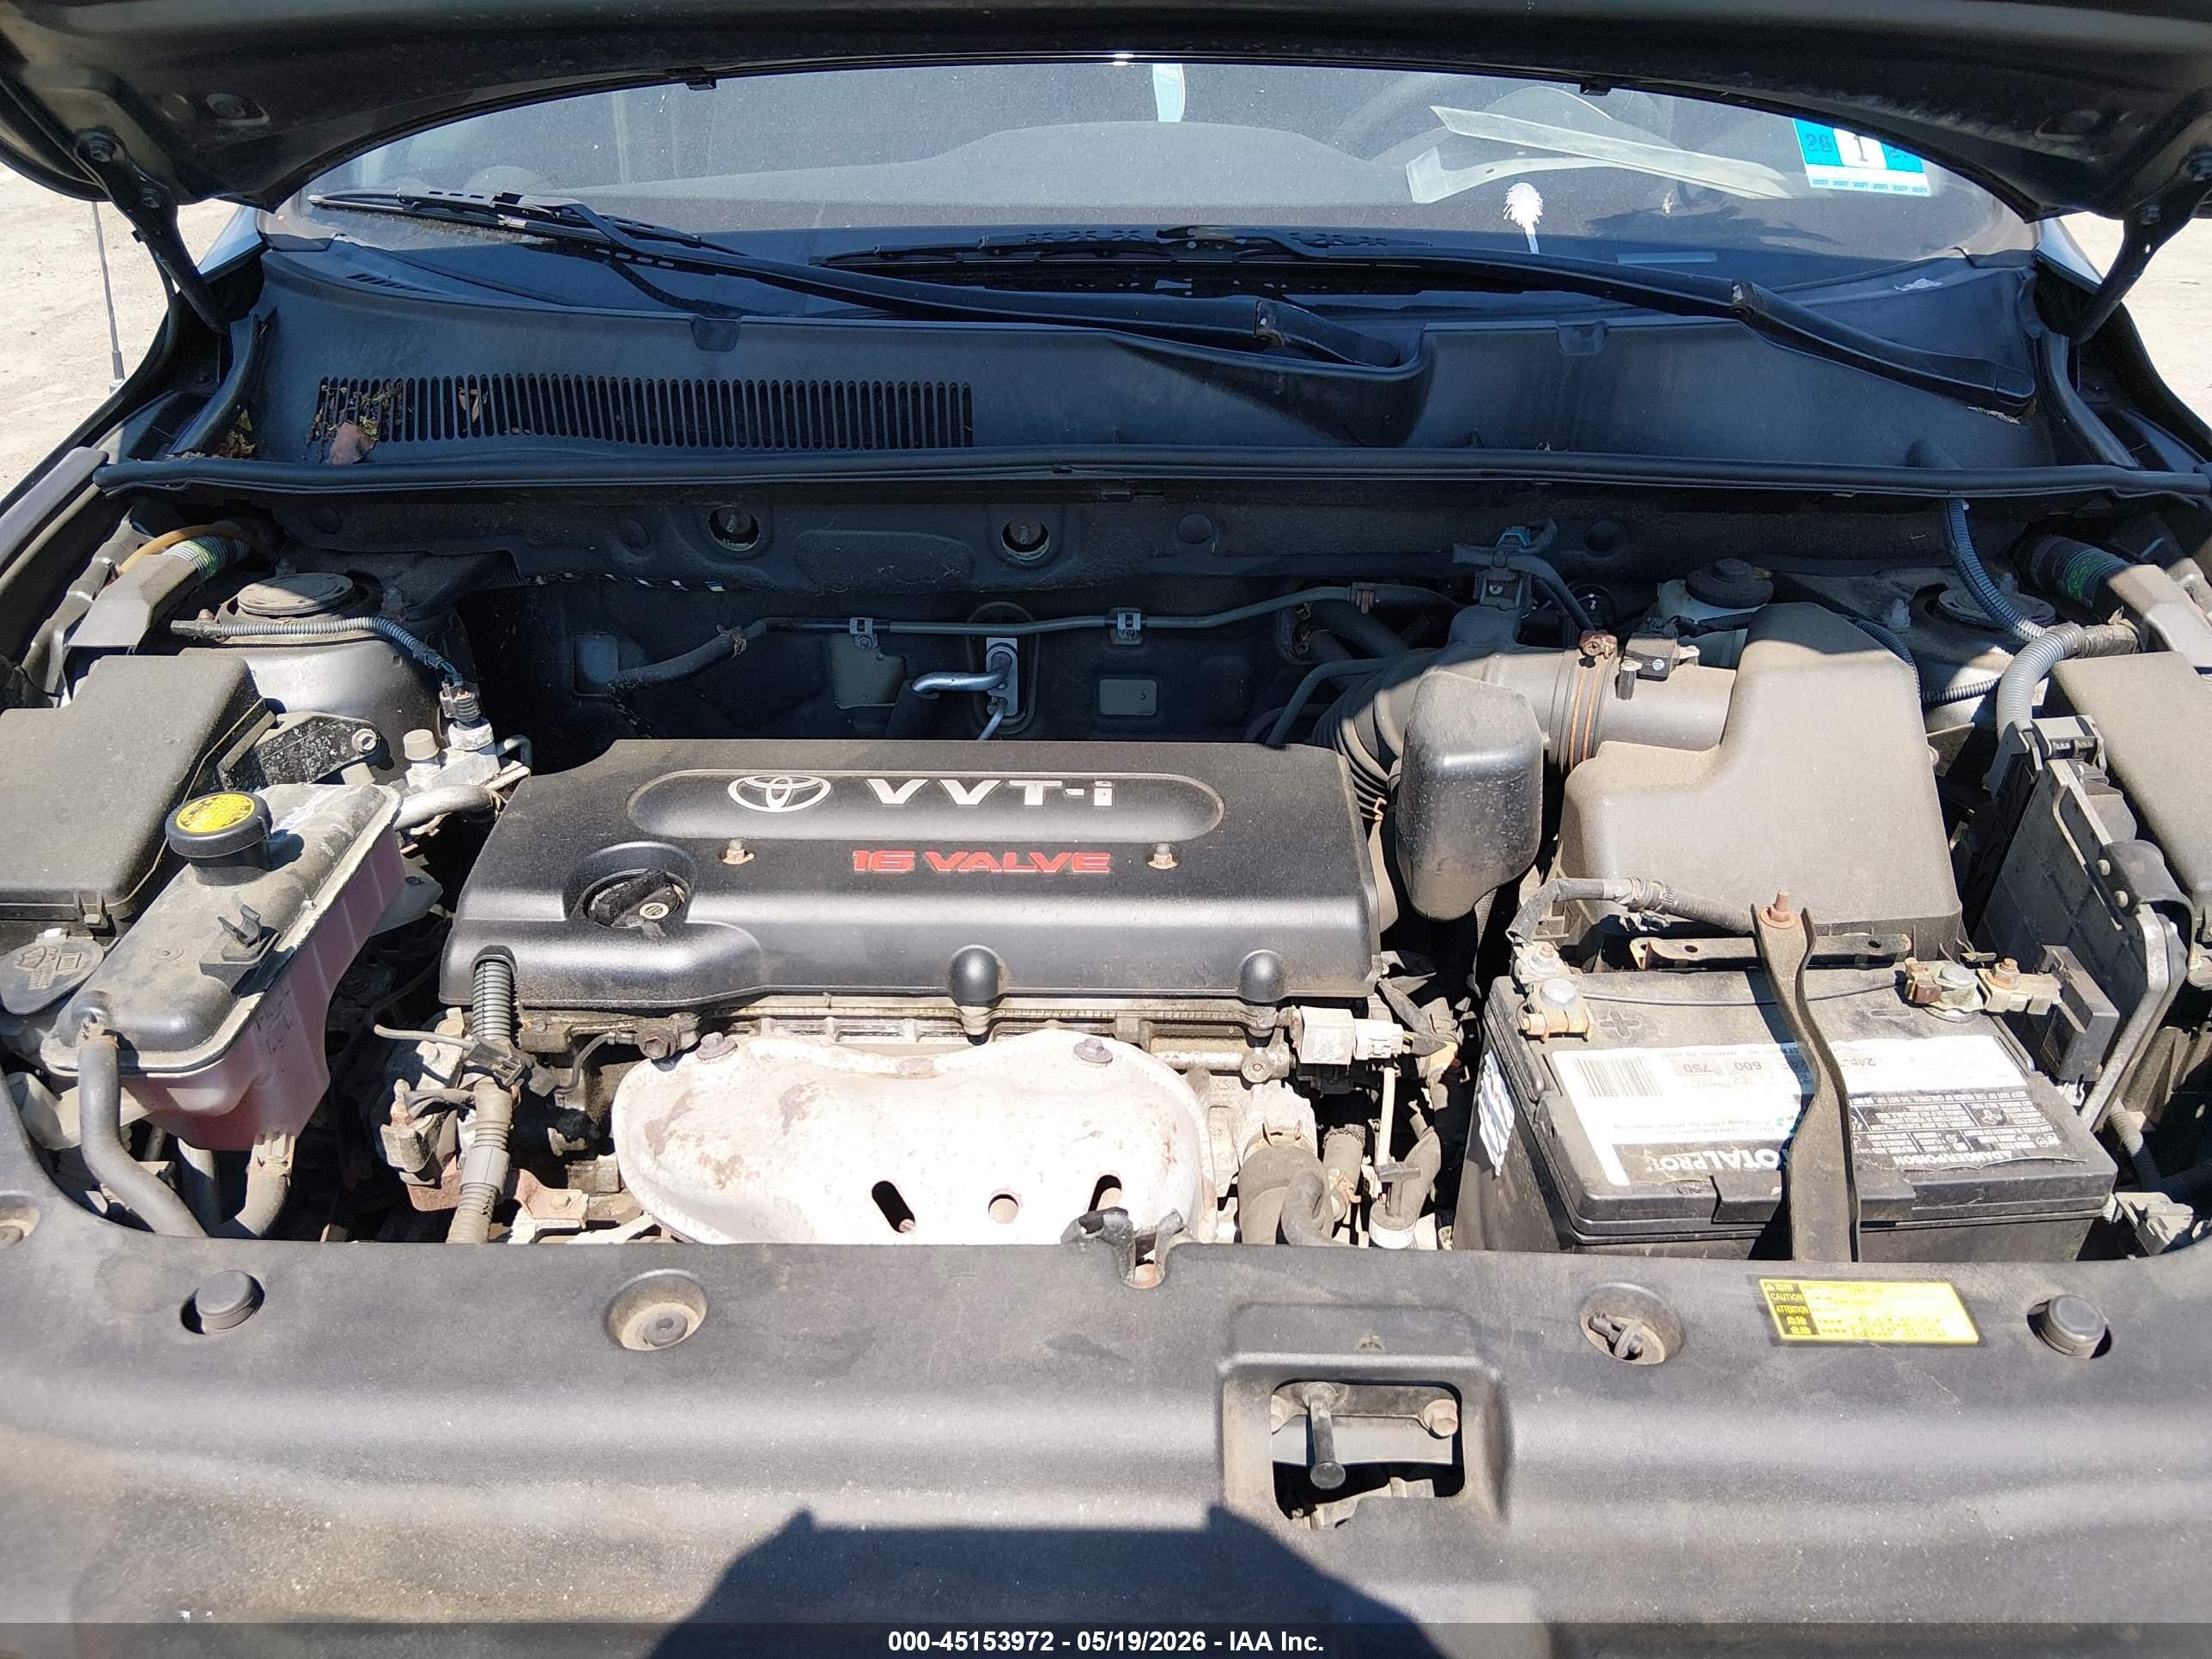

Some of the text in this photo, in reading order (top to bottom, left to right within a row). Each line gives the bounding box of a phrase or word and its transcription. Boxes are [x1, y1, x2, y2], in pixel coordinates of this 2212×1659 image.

[866, 778, 1114, 806] VVT-i
[853, 850, 1112, 874] 16 VALVE
[1682, 1060, 1763, 1073] 600 750
[1770, 1291, 1805, 1302] CAUTION
[1775, 1304, 1809, 1315] ATTENTION
